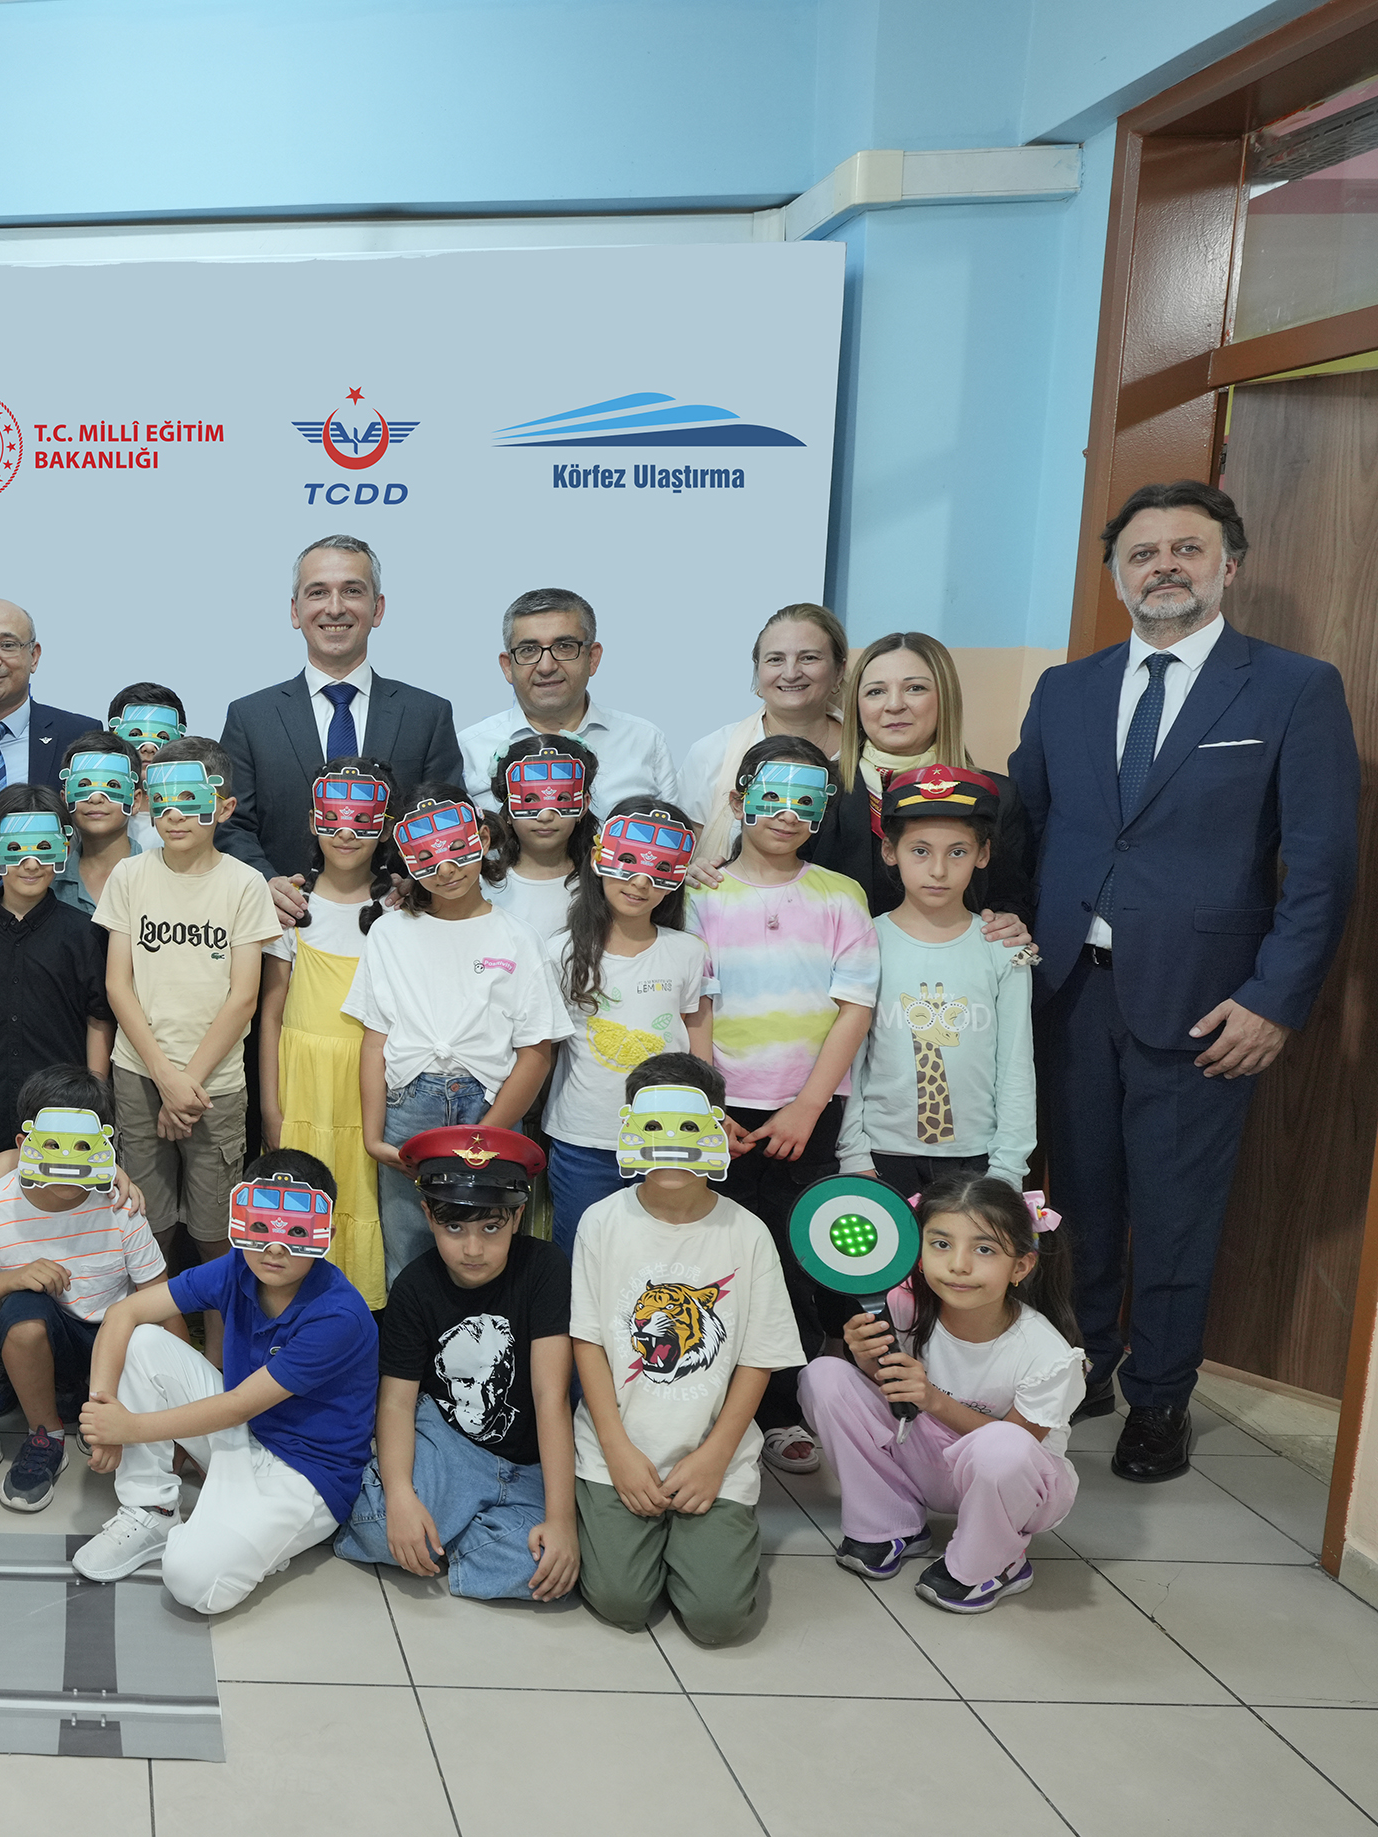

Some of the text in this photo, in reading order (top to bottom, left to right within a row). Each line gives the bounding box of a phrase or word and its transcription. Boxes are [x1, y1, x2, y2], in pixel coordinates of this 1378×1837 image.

[33, 420, 225, 442] T.C. MİLLÎ EĞİTİM
[34, 447, 159, 469] BAKANLIĞI
[553, 463, 745, 493] Körfez Ulaştırma
[303, 483, 409, 505] TCDD
[136, 914, 228, 953] Lacoste
[919, 992, 956, 1000] HAPPY
[636, 1375, 709, 1402] FEARLESS
[708, 1356, 732, 1388] WILD
